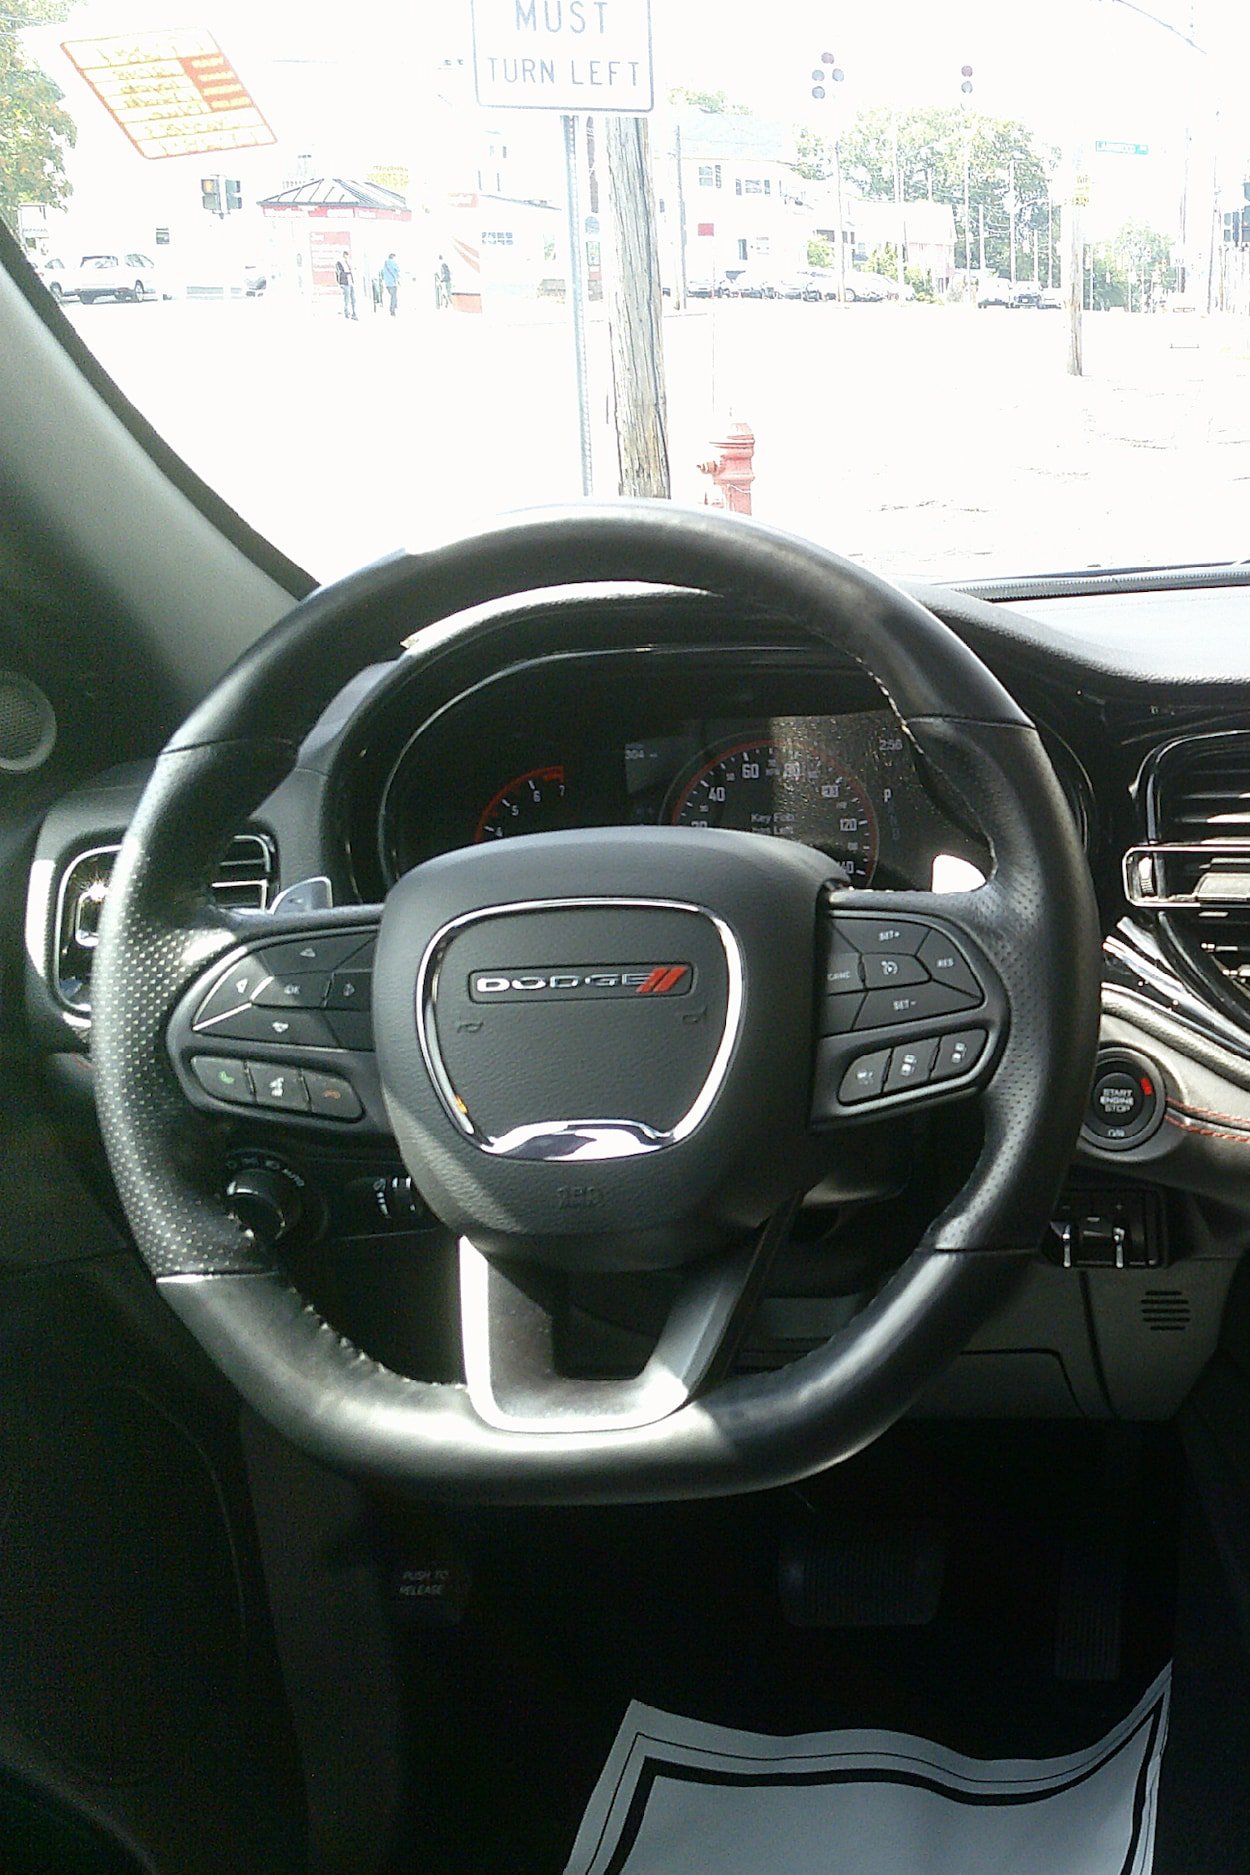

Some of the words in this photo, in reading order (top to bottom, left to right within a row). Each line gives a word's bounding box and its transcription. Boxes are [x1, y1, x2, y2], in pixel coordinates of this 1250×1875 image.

[515, 0, 608, 34] MUST
[488, 57, 555, 84] TURN
[571, 60, 639, 86] LEFT
[742, 763, 759, 779] 60
[532, 790, 542, 803] 6
[708, 787, 726, 802] 40
[839, 818, 857, 832] 120
[476, 972, 653, 993] DODGE
[1103, 1088, 1133, 1097] START
[1099, 1096, 1134, 1106] ENGINE
[1104, 1105, 1131, 1113] STOP
